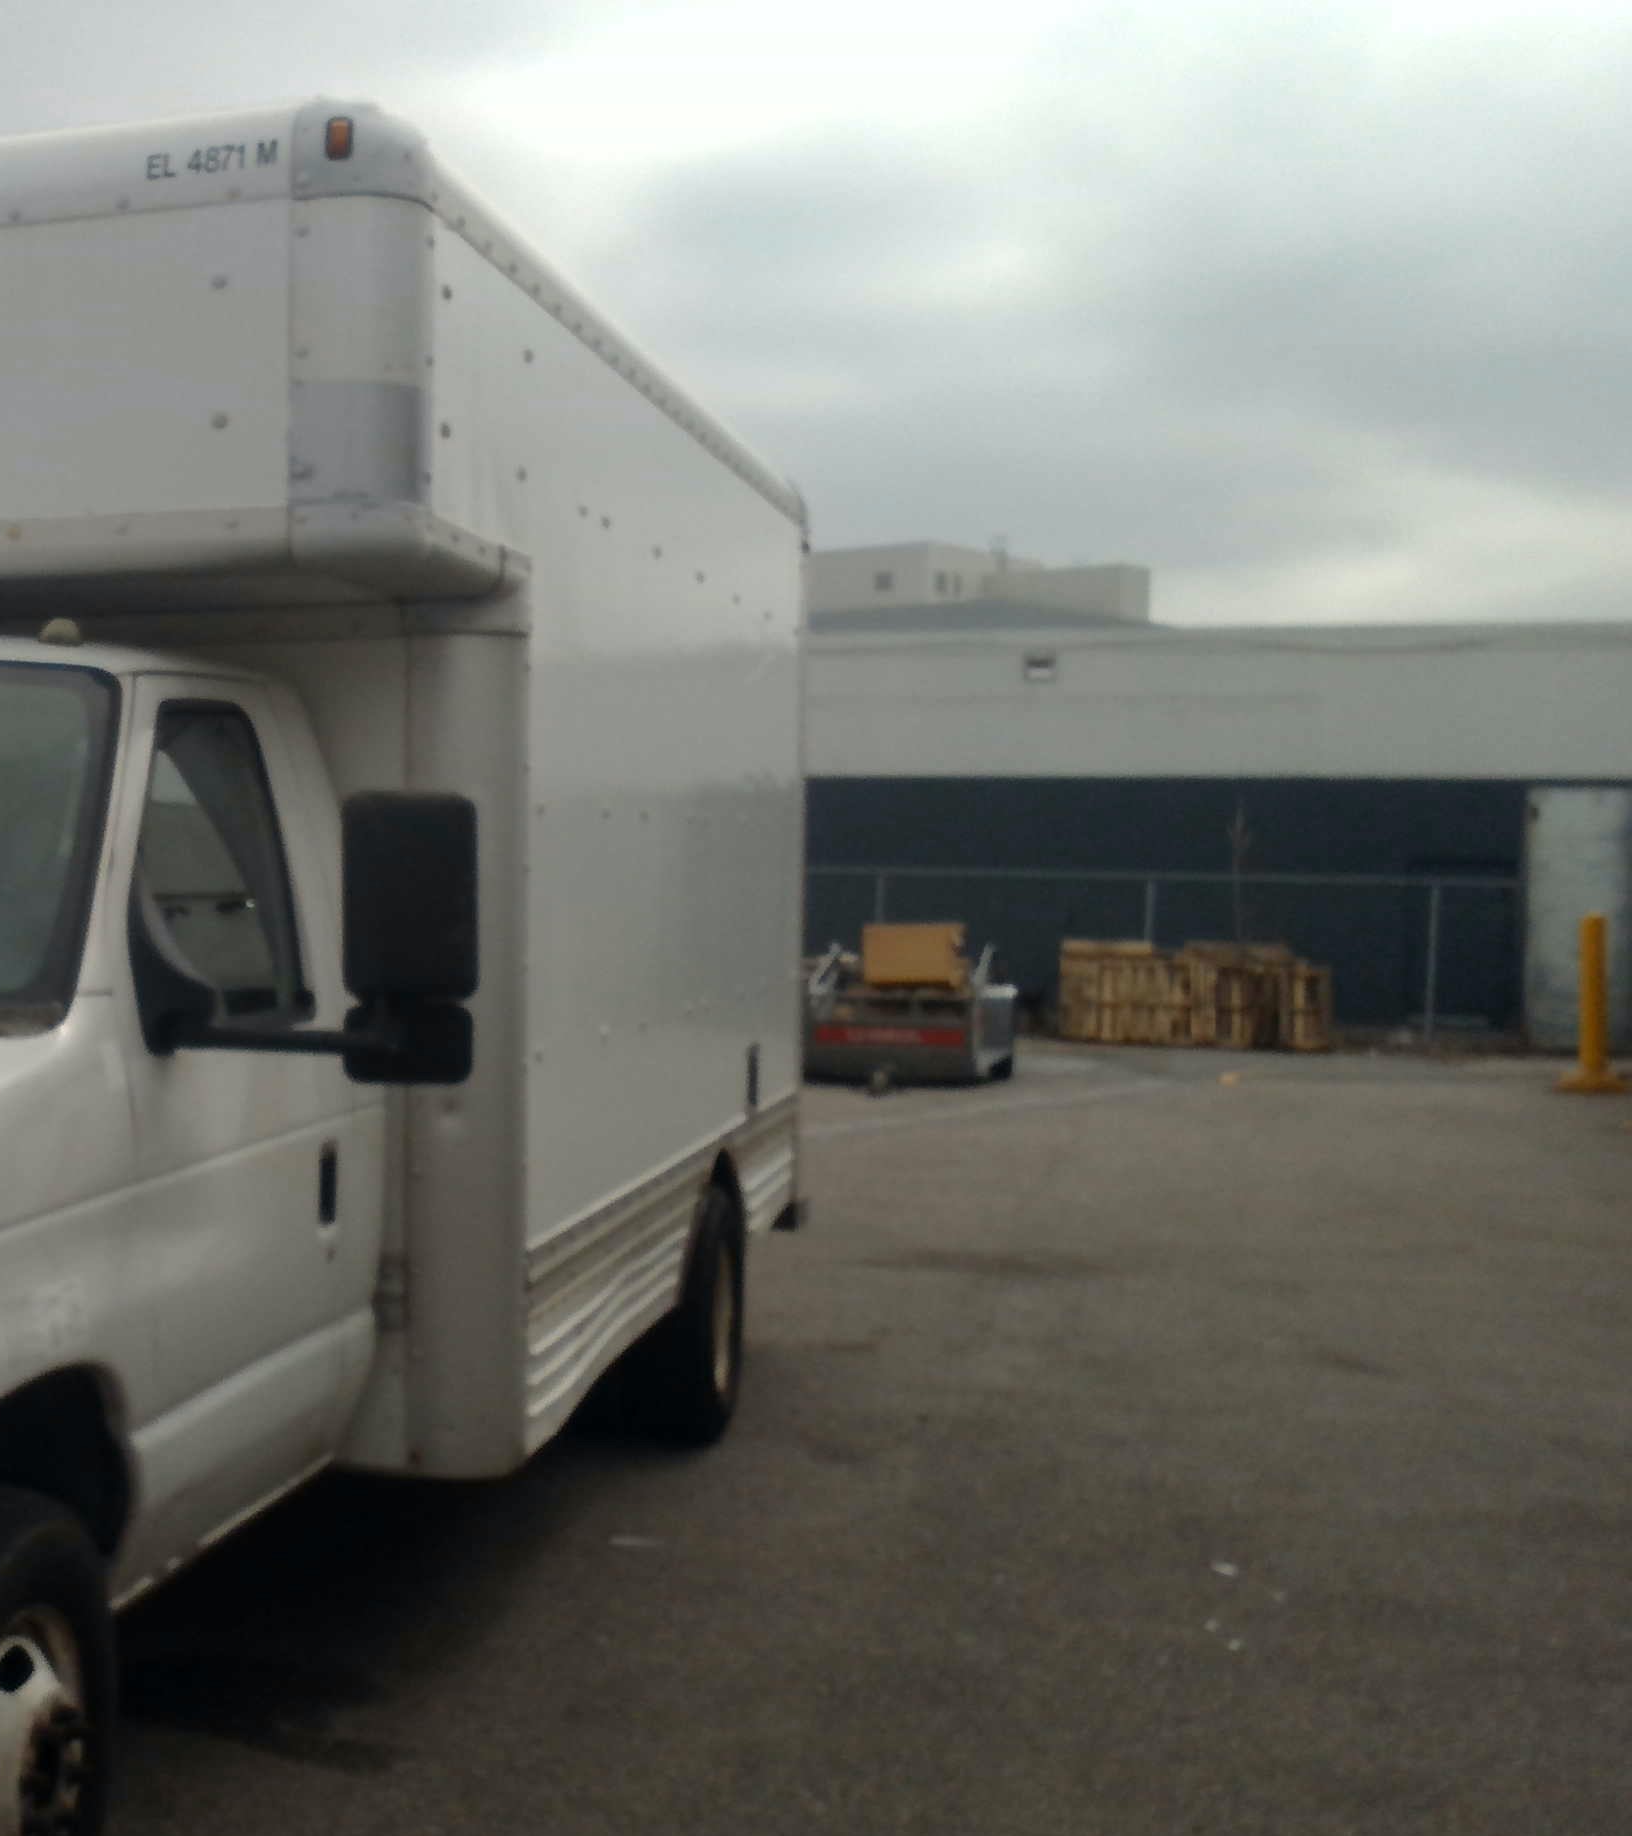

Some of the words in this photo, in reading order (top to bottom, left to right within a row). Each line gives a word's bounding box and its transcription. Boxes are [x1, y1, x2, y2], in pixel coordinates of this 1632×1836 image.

[145, 153, 176, 180] EL
[187, 145, 245, 173] 4871
[256, 139, 279, 167] M
